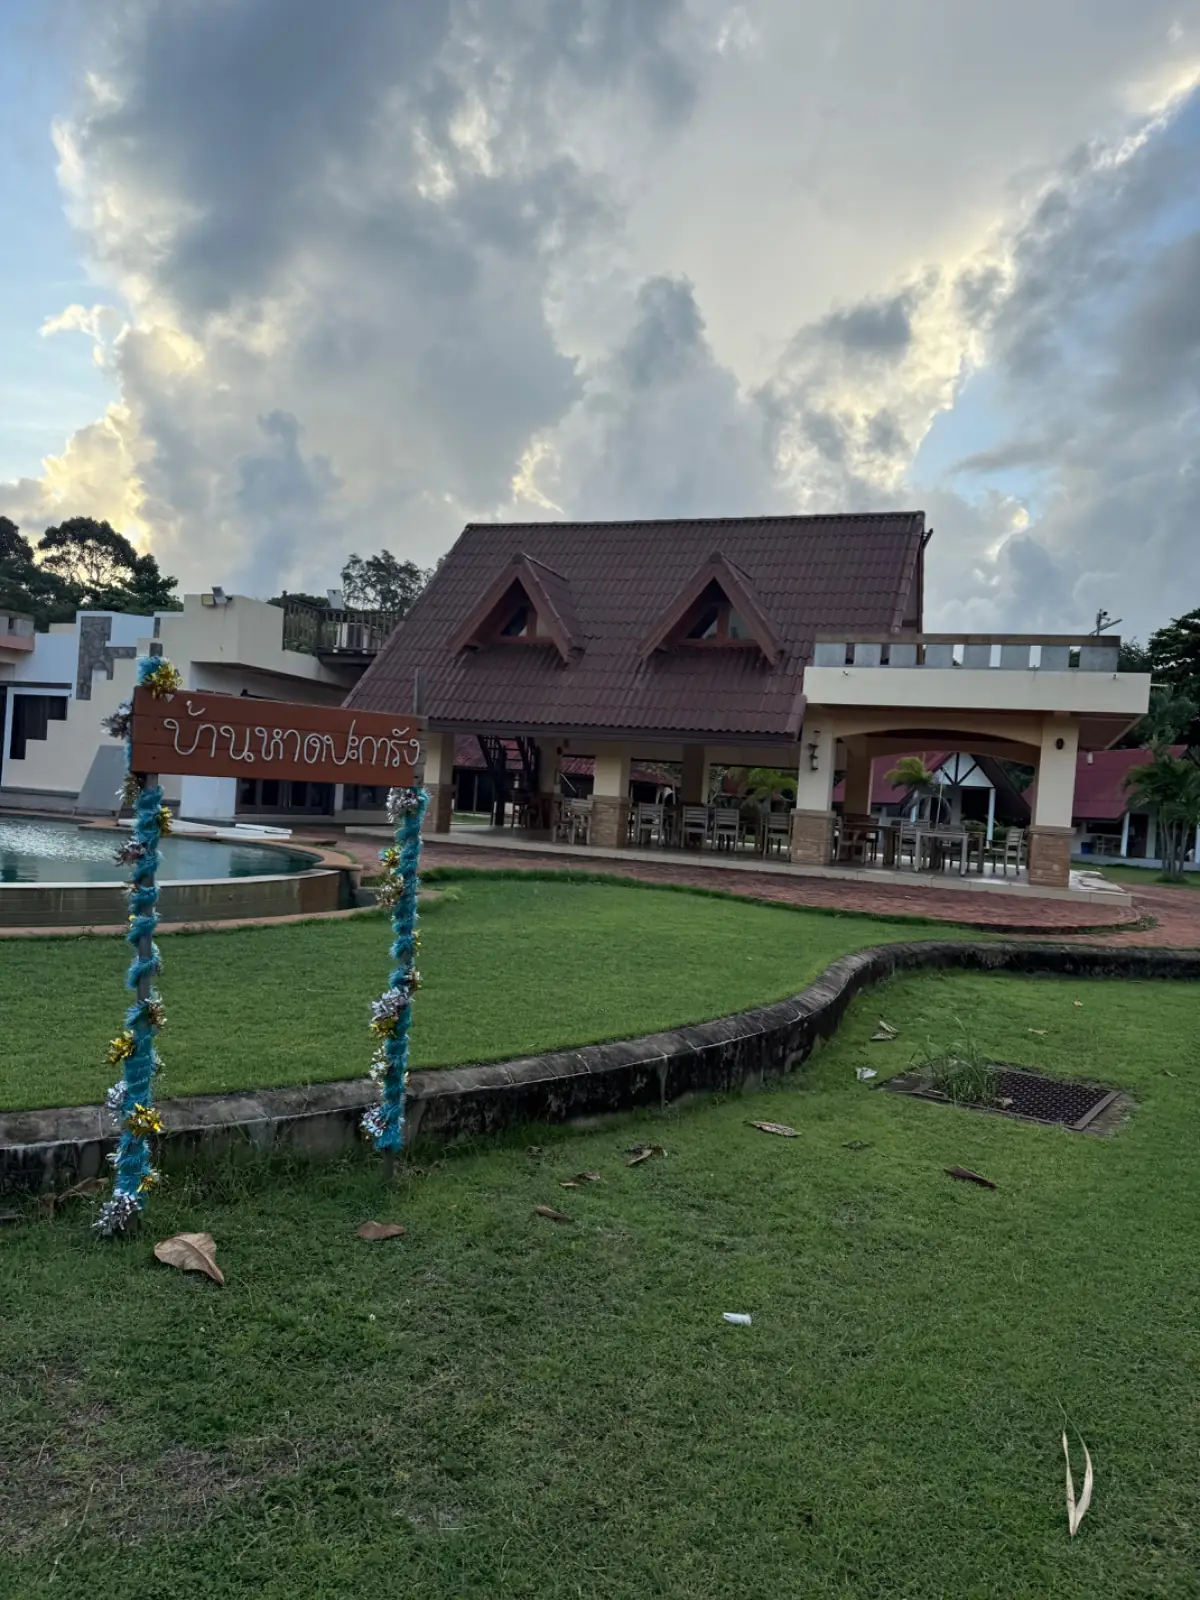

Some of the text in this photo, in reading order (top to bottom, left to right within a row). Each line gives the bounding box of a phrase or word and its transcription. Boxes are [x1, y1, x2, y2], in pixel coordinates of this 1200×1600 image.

[163, 700, 421, 768] บ้านหาดปะการัง
